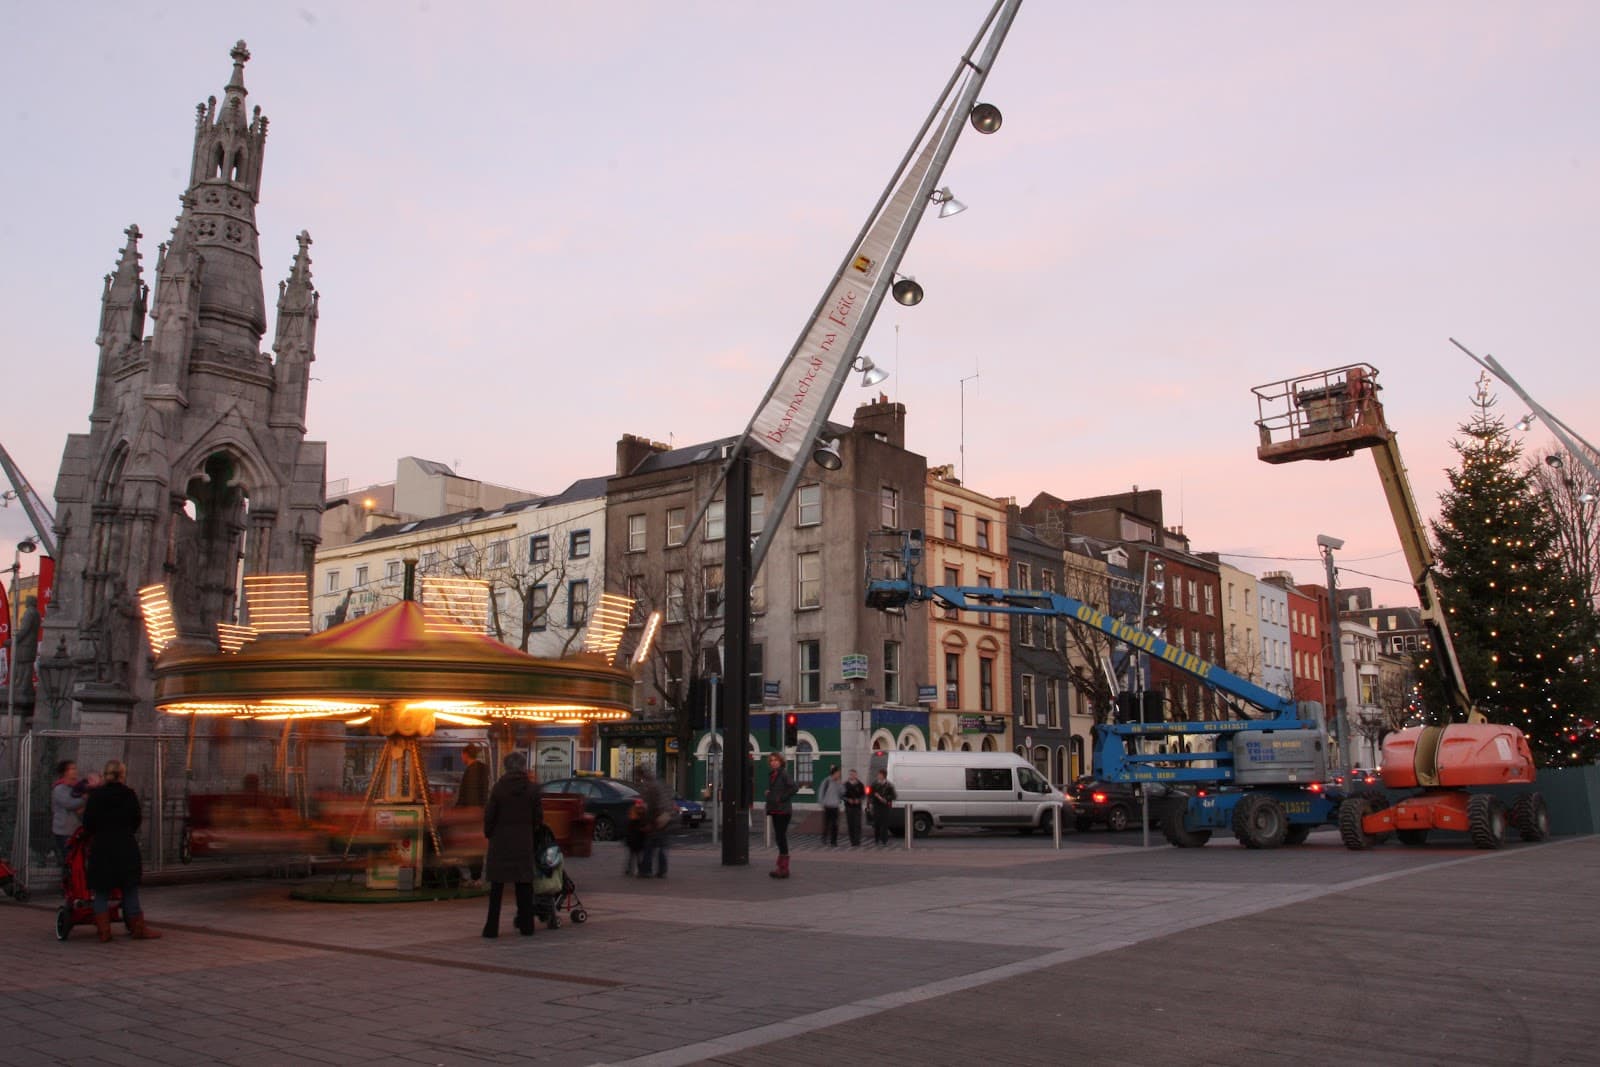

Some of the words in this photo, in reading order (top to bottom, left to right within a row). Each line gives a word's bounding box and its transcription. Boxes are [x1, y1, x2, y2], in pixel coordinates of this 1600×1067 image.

[821, 333, 837, 352] na
[1077, 606, 1103, 628] OK
[1111, 620, 1157, 653] TOOL
[1161, 644, 1213, 678] HIRE
